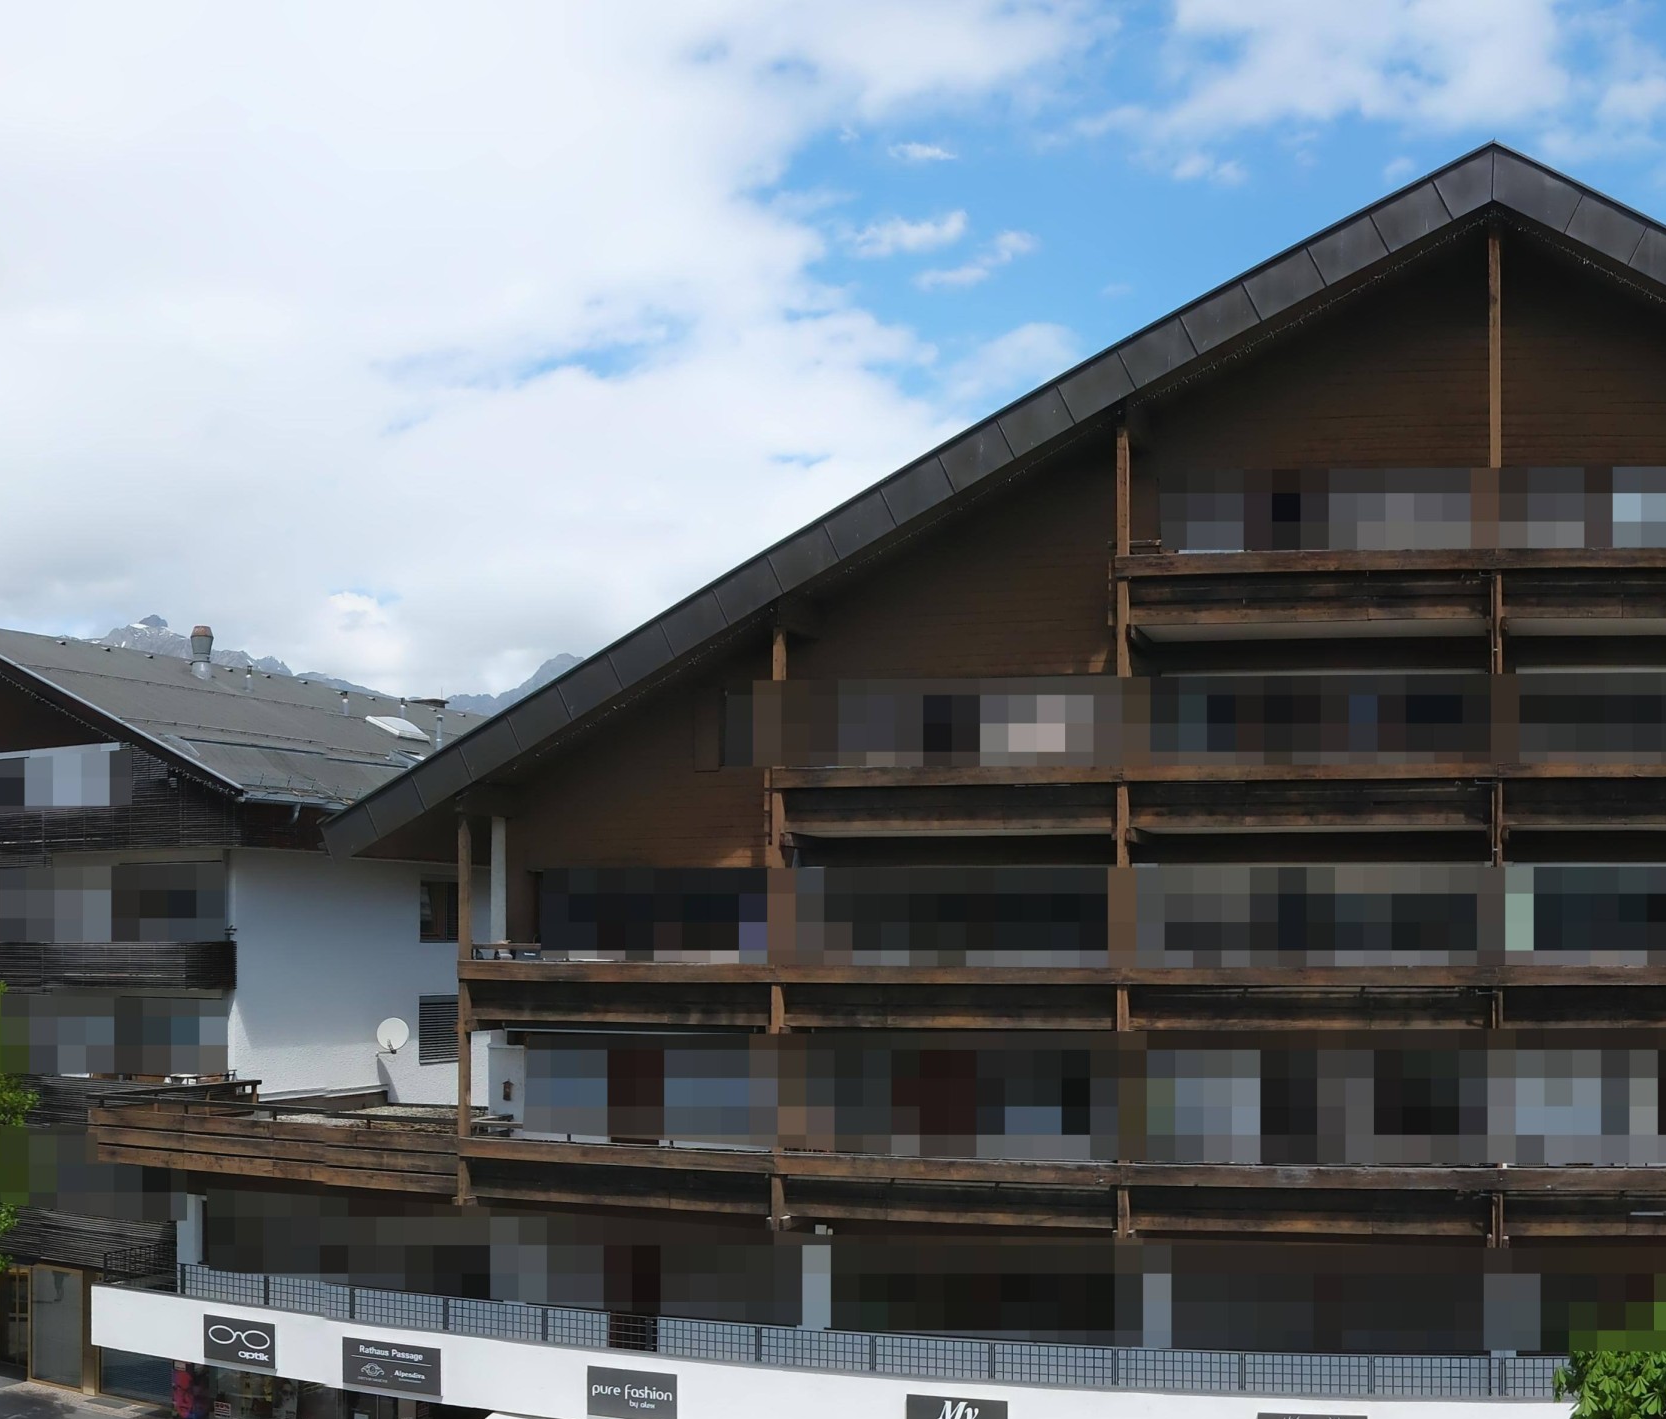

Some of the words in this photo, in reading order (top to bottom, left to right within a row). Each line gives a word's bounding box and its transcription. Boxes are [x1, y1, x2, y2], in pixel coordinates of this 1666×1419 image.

[238, 1350, 270, 1362] optik
[359, 1344, 389, 1357] Rathaus
[391, 1349, 424, 1361] Passage
[592, 1384, 621, 1397] pure
[624, 1384, 673, 1401] fashion
[629, 1399, 639, 1409] by
[640, 1401, 656, 1409] alex
